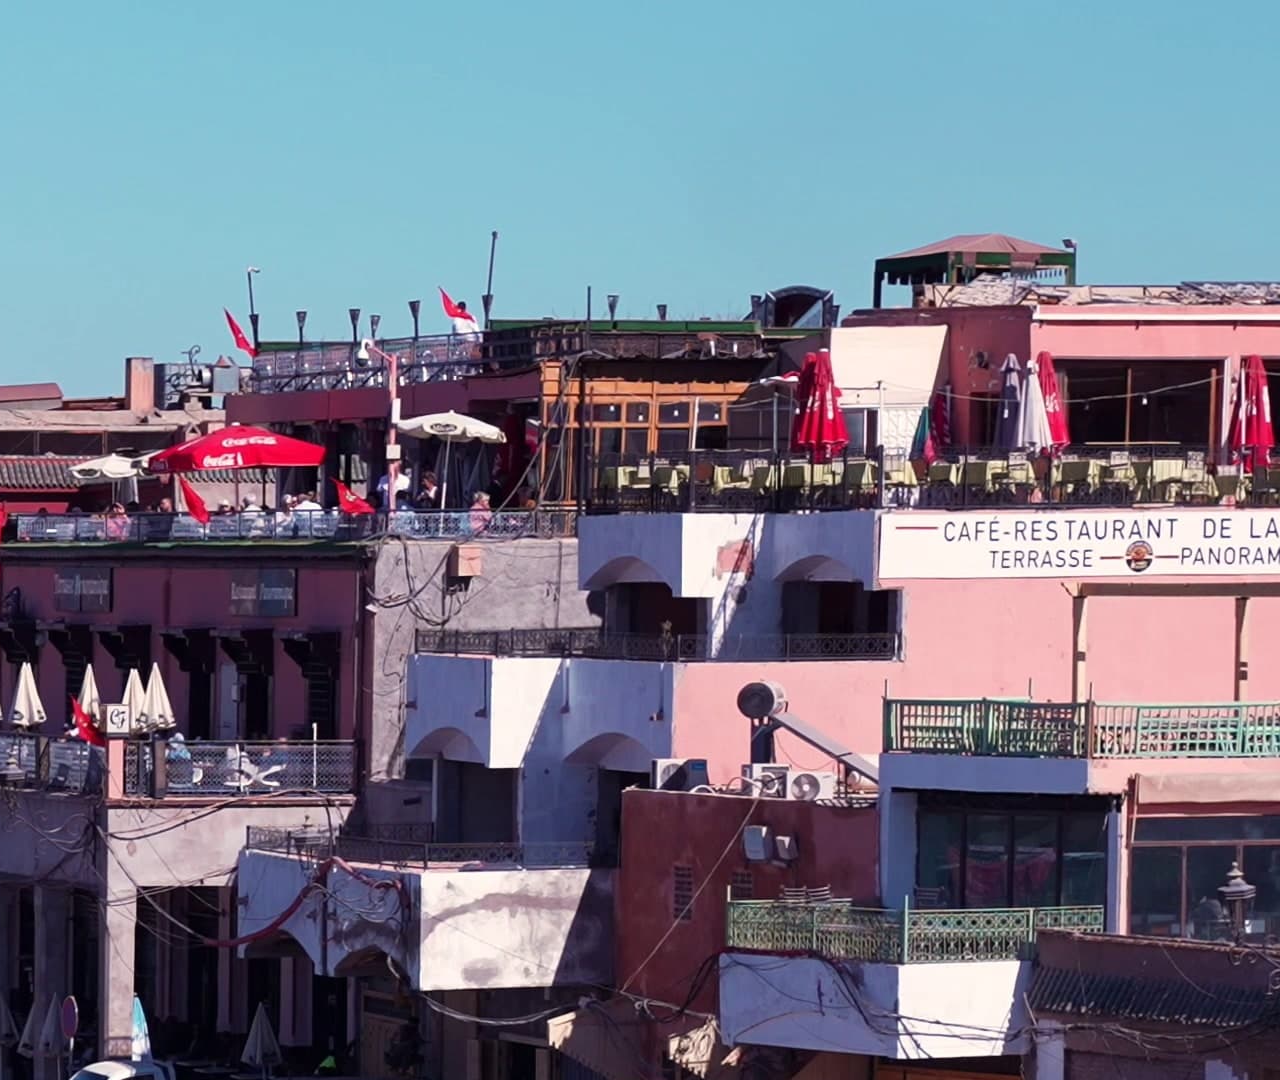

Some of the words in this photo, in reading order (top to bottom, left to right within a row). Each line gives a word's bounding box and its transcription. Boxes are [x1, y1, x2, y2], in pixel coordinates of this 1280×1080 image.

[943, 516, 1178, 543] CAFÉ-RESTAURANT
[1203, 518, 1232, 539] DE
[1249, 517, 1280, 539] LA
[989, 549, 1093, 569] TERRASSE
